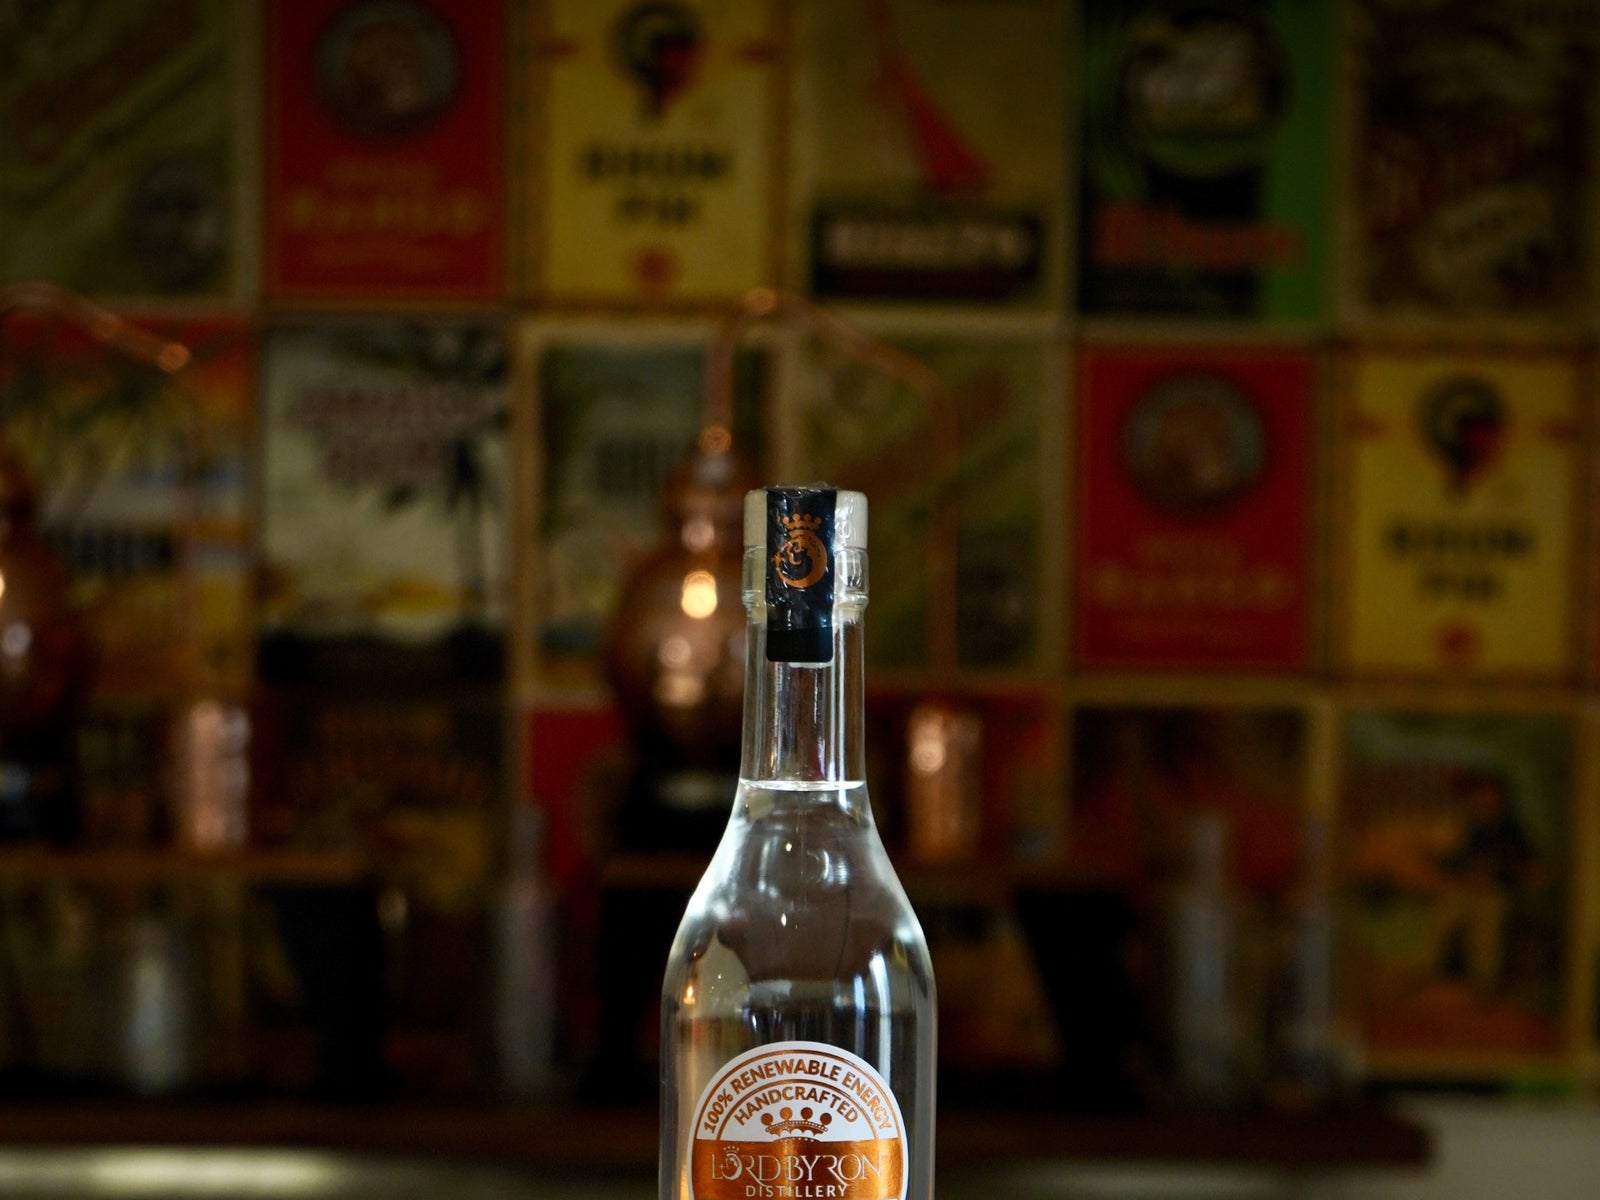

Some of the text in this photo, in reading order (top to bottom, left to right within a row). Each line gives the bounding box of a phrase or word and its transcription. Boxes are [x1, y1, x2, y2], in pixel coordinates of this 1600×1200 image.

[704, 1058, 892, 1133] 100% RENEWABLE ENERGY
[734, 1086, 859, 1126] HANDCRAFTED
[711, 1152, 881, 1188] LORD BYRON
[745, 1184, 847, 1198] DISTILLERY
